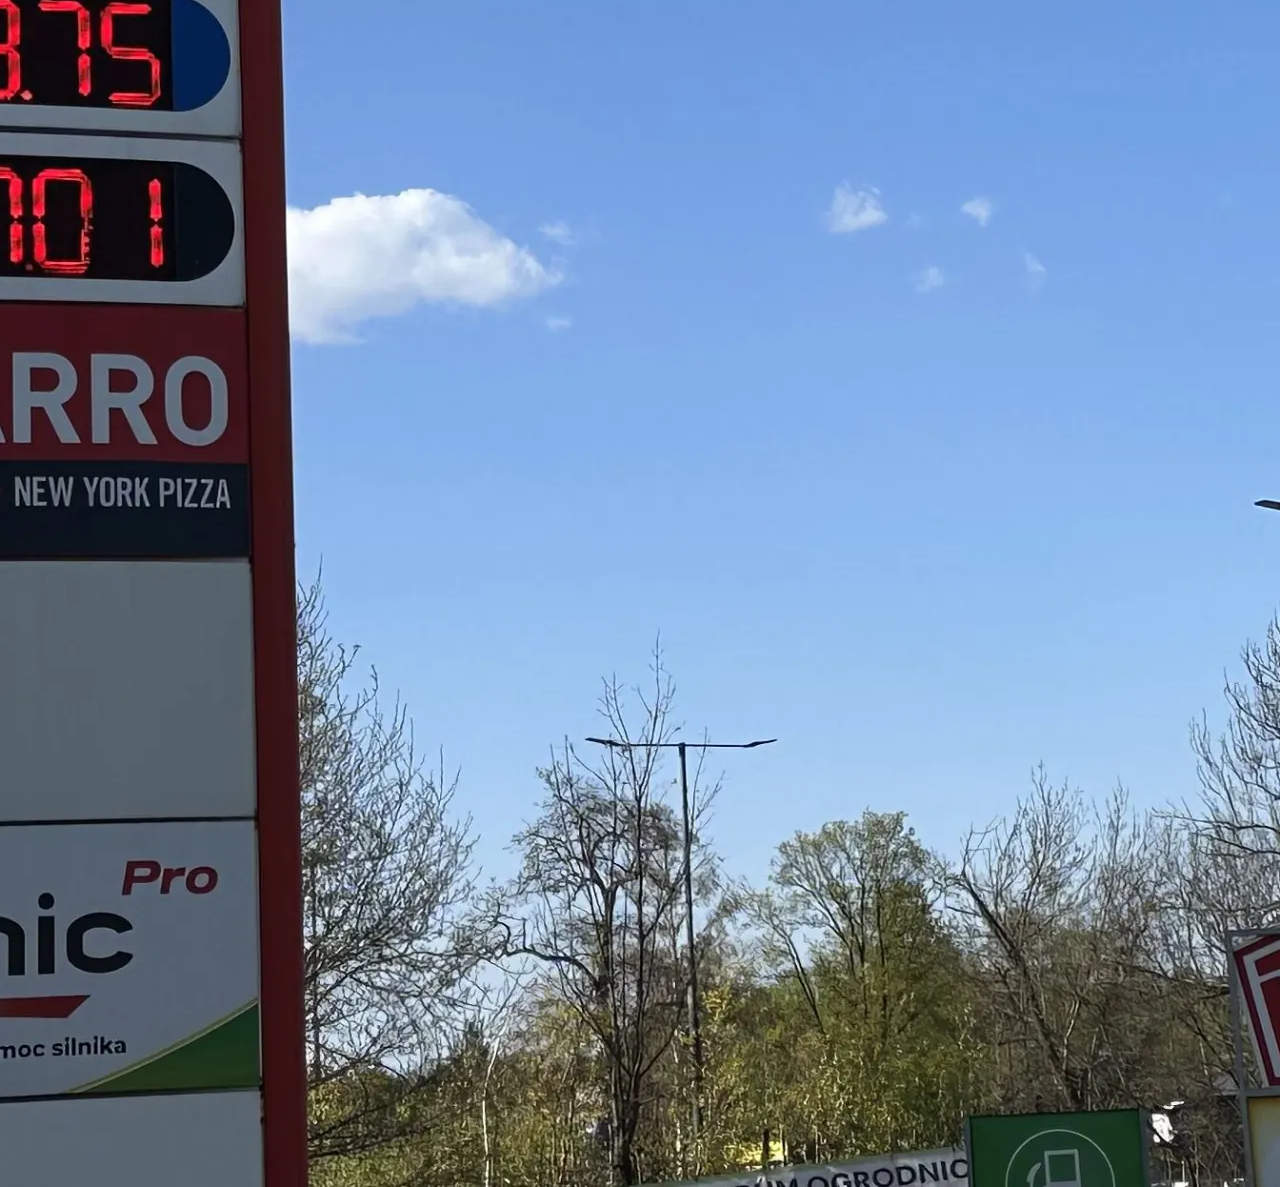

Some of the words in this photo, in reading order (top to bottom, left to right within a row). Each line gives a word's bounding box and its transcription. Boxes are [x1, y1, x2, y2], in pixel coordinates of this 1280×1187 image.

[14, 476, 74, 508] NEW
[83, 476, 151, 508] YORK
[159, 478, 231, 509] PIZZA
[121, 859, 218, 896] Pro
[52, 1034, 127, 1058] silnika
